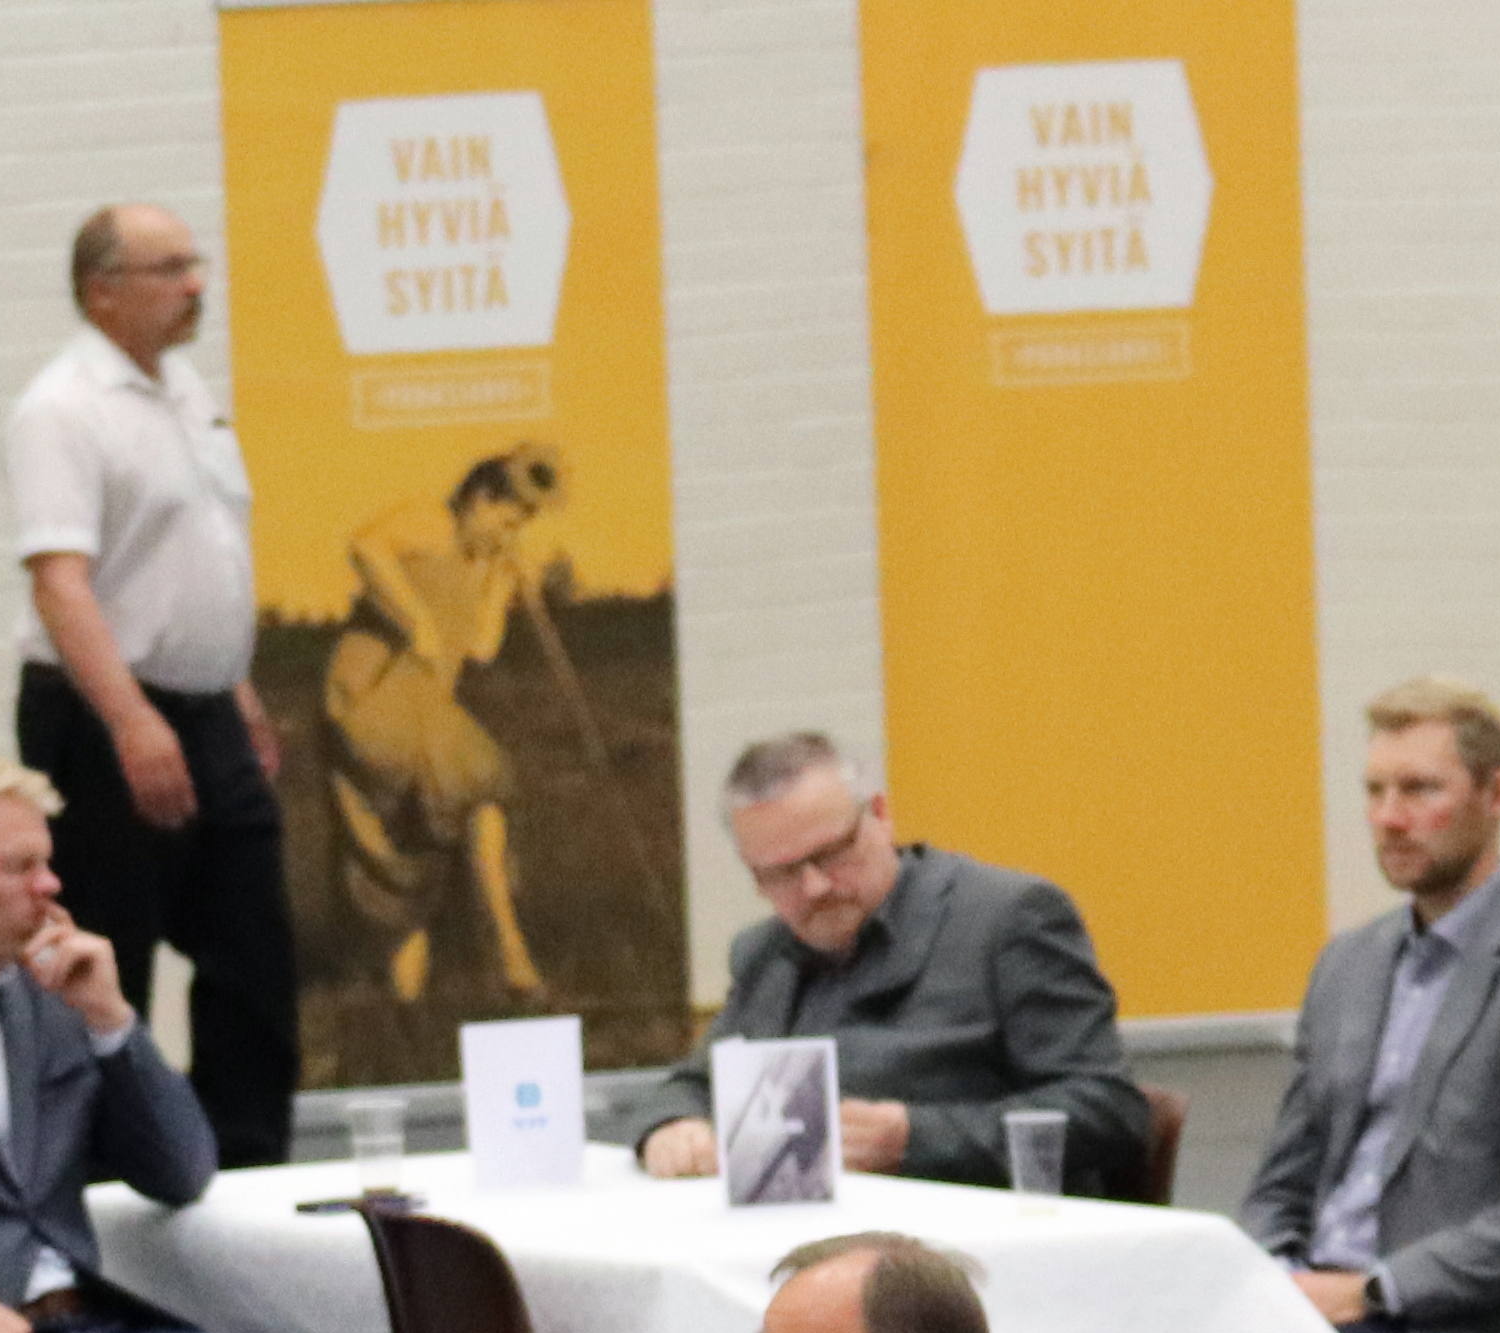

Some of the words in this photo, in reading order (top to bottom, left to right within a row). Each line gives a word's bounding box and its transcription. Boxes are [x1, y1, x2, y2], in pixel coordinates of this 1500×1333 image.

[1028, 102, 1133, 148] VAIN
[389, 134, 493, 183] VAIN
[1014, 145, 1152, 213] HYVIÄ
[375, 182, 511, 247] HYVIÄ
[1022, 215, 1150, 278] SYITÄ
[383, 251, 509, 317] SYITÄ
